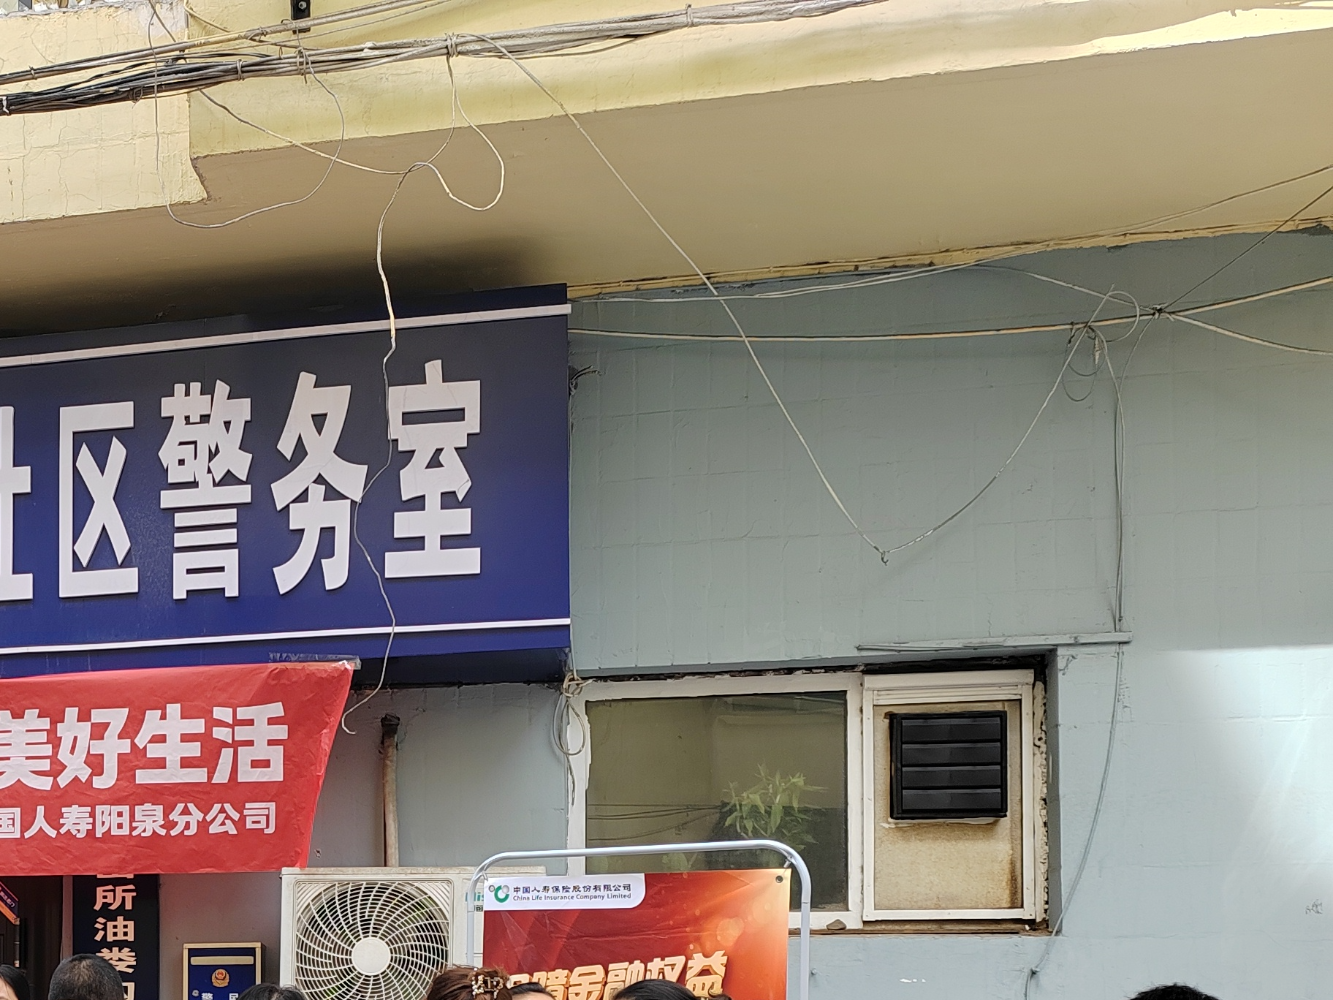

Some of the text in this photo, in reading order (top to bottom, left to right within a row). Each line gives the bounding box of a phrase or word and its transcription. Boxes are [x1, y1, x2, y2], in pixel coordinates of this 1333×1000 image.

[513, 884, 632, 894] 中国人寿保险股份有限公司
